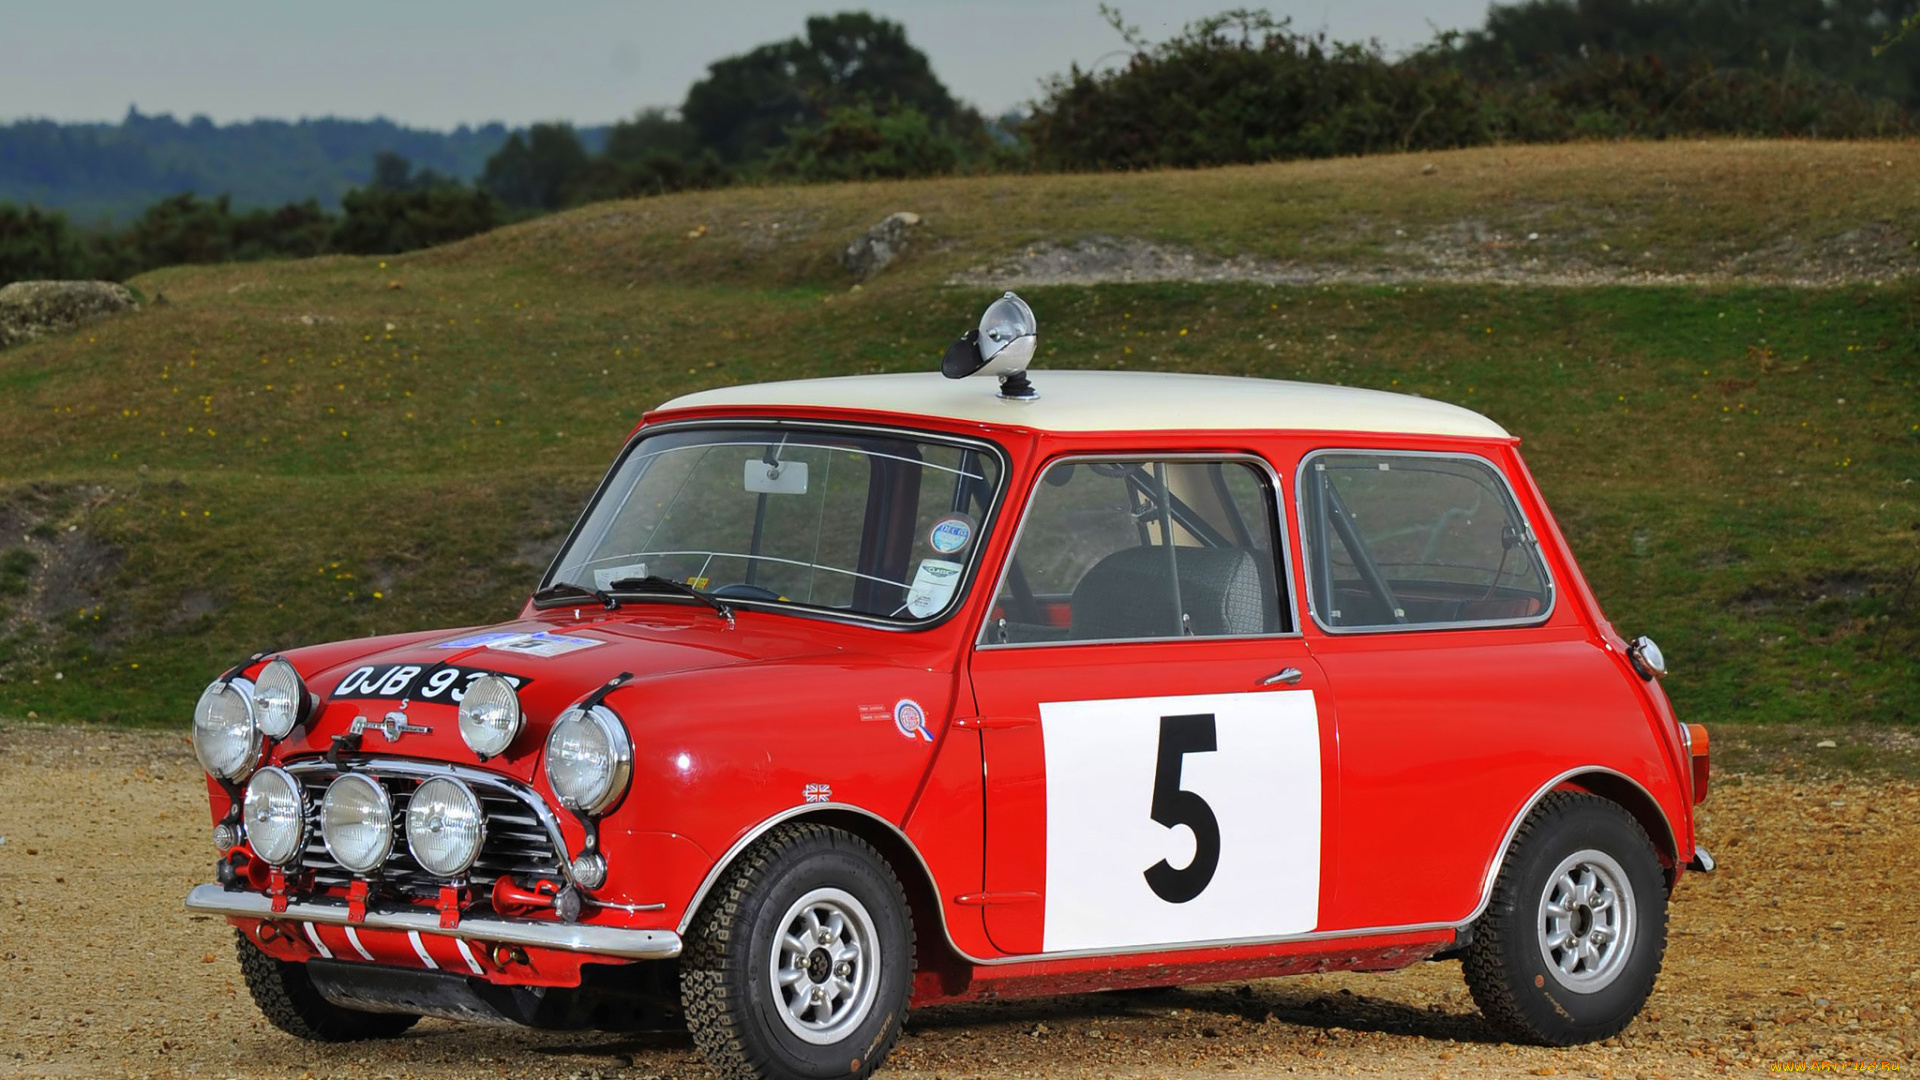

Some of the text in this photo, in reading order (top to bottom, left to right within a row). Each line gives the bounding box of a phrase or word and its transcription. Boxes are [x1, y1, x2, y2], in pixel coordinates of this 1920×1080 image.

[334, 665, 520, 702] DJB 93
[398, 698, 410, 710] S
[1143, 713, 1221, 904] 5
